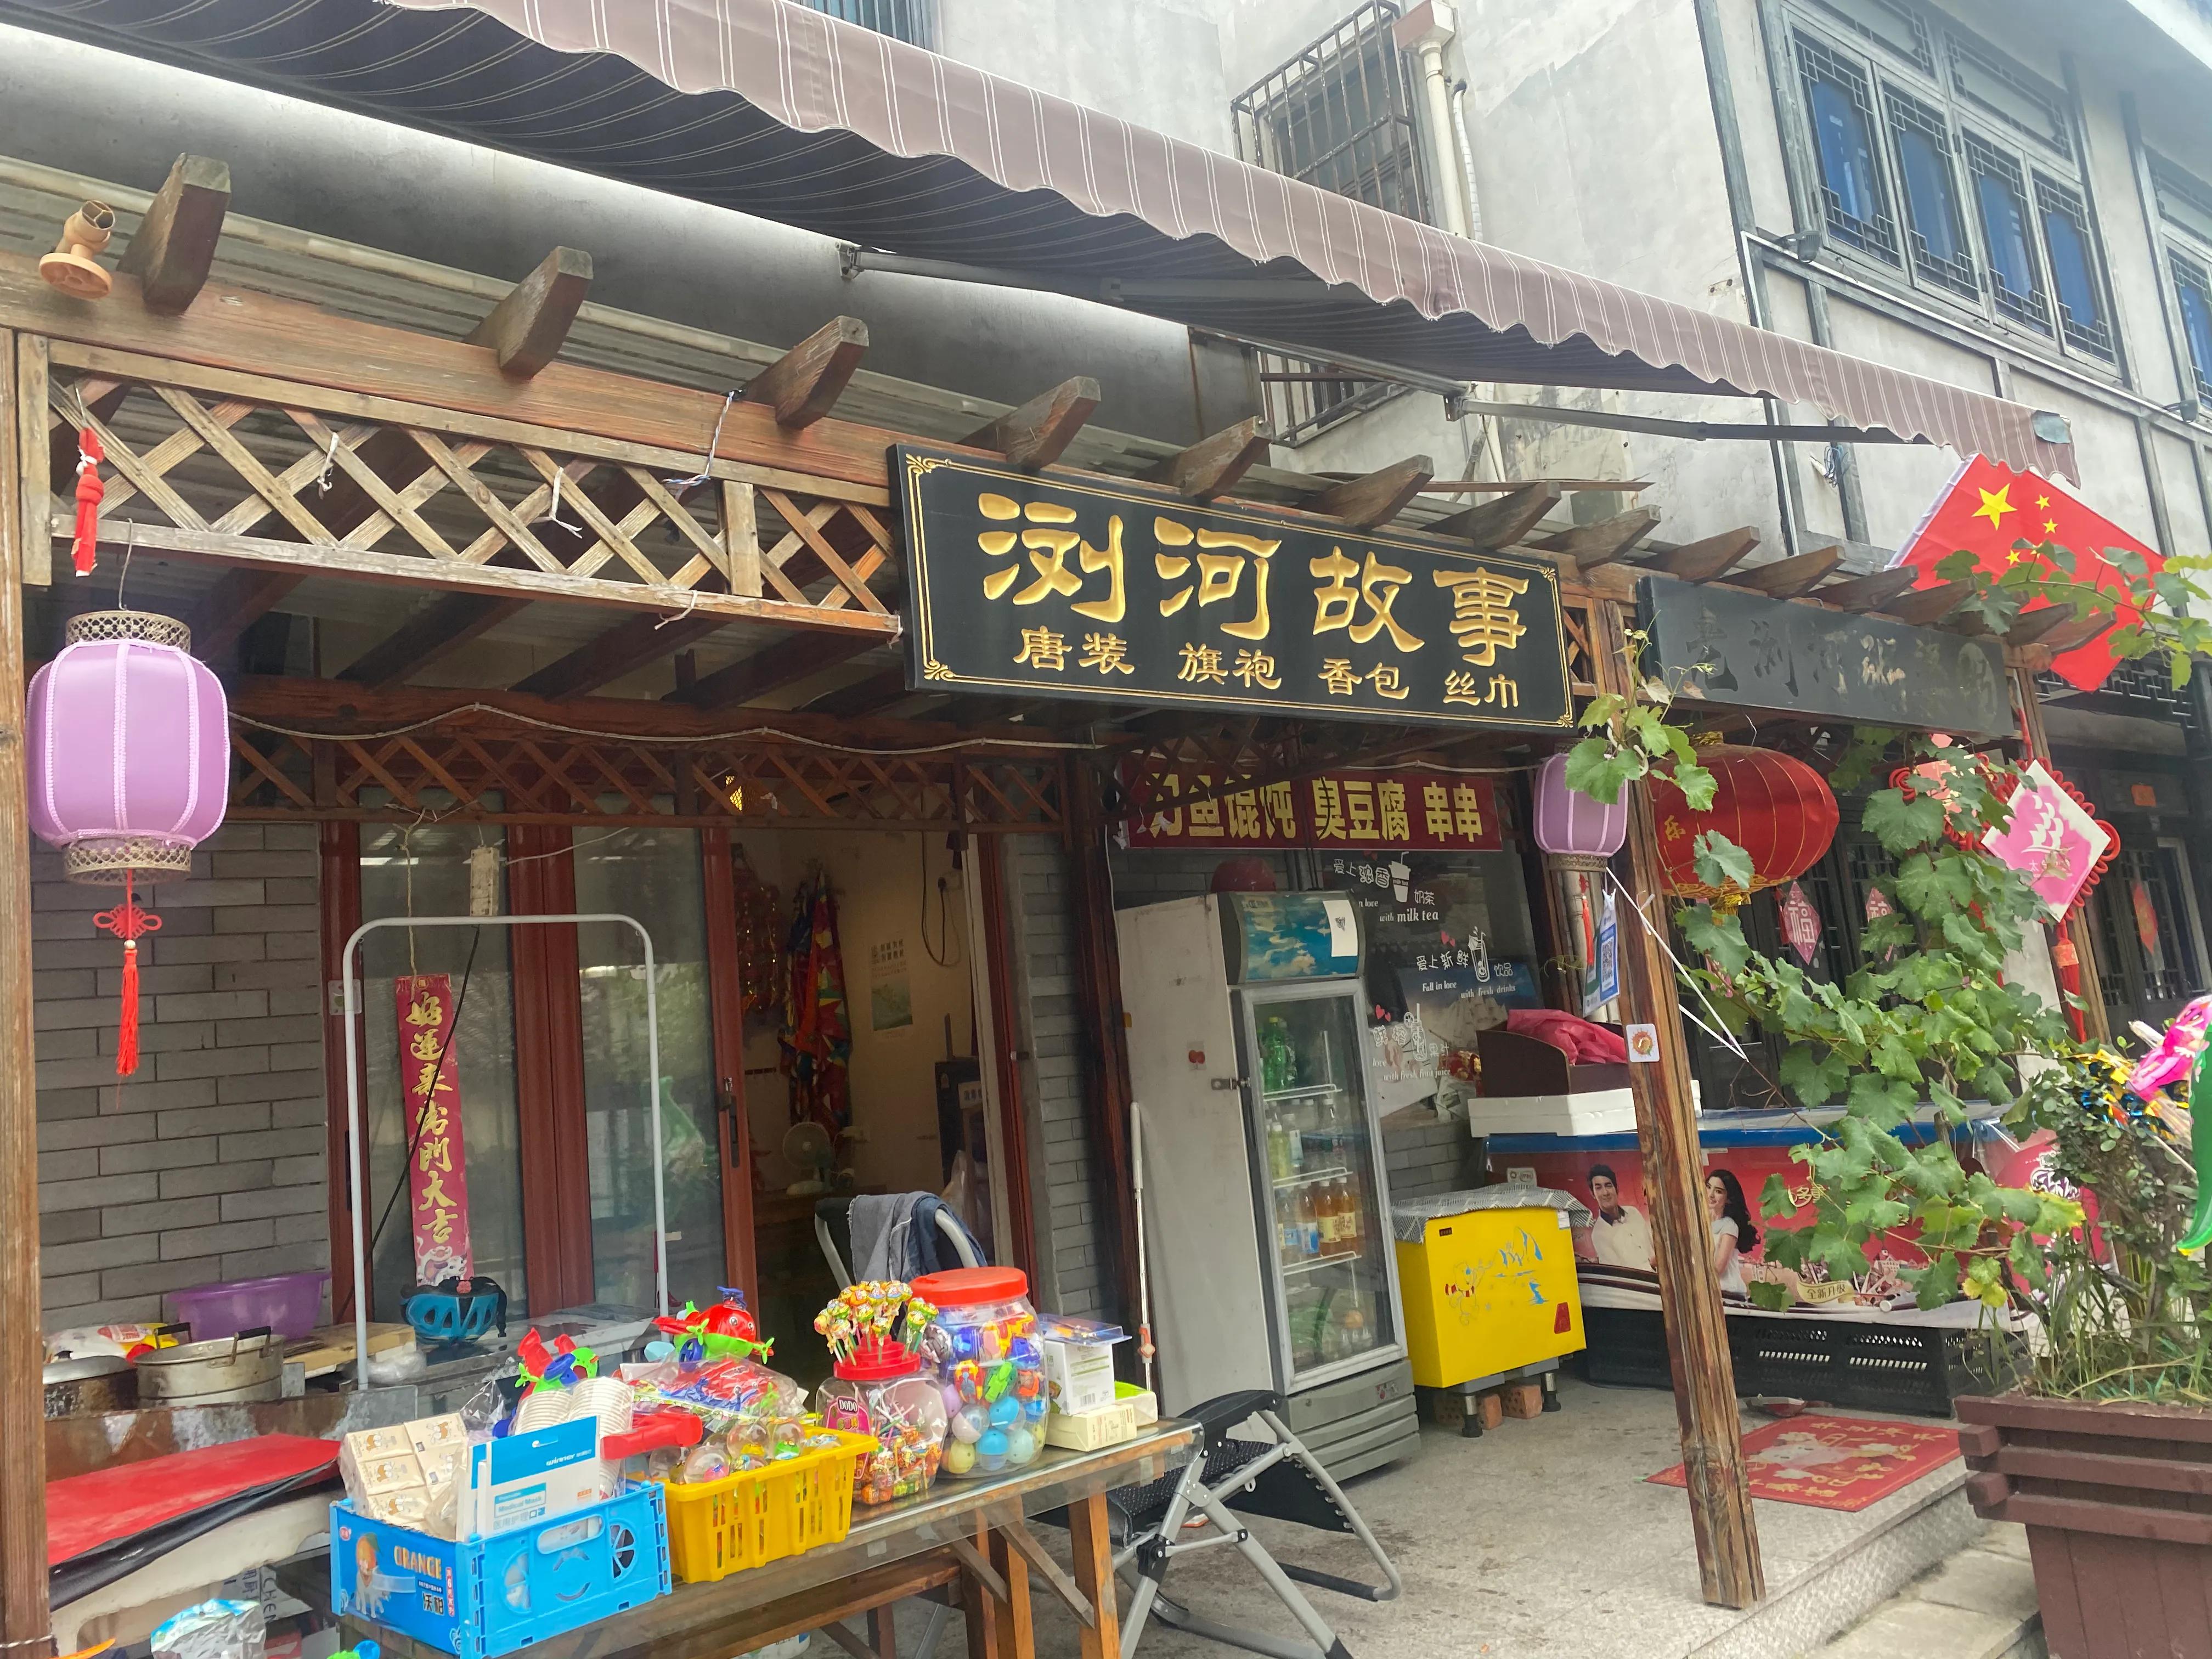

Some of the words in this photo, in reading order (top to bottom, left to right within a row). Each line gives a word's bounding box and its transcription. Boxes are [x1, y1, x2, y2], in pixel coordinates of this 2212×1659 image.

[978, 493, 1529, 666] 浏河故事
[1013, 625, 1135, 674] 唐装
[1178, 642, 1282, 690] 旗袍
[1318, 658, 1409, 699] 香包
[1443, 670, 1519, 708] 丝巾
[1312, 776, 1410, 840] 臭豆腐
[1423, 781, 1483, 842] 串串
[1365, 898, 1378, 907] love
[1414, 889, 1435, 905] 奶茶
[1380, 913, 1394, 922] with
[1397, 908, 1419, 922] milk
[1423, 910, 1438, 921] tea
[1416, 949, 1469, 971] 爱上新鲜
[1494, 962, 1513, 977] 饮品
[1422, 982, 1434, 992] Fall
[1435, 981, 1442, 990] in
[1444, 980, 1457, 989] love
[1461, 988, 1475, 998] with
[1478, 987, 1493, 996] fresh
[1497, 984, 1516, 994] drinks
[1373, 1058, 1386, 1067] love
[1384, 1071, 1398, 1081] with
[1401, 1070, 1417, 1080] fresh
[1435, 1067, 1451, 1078] juice
[1807, 1283, 1846, 1299] 全新升级
[839, 1399, 858, 1412] DODO
[394, 1545, 442, 1580] ORANGE
